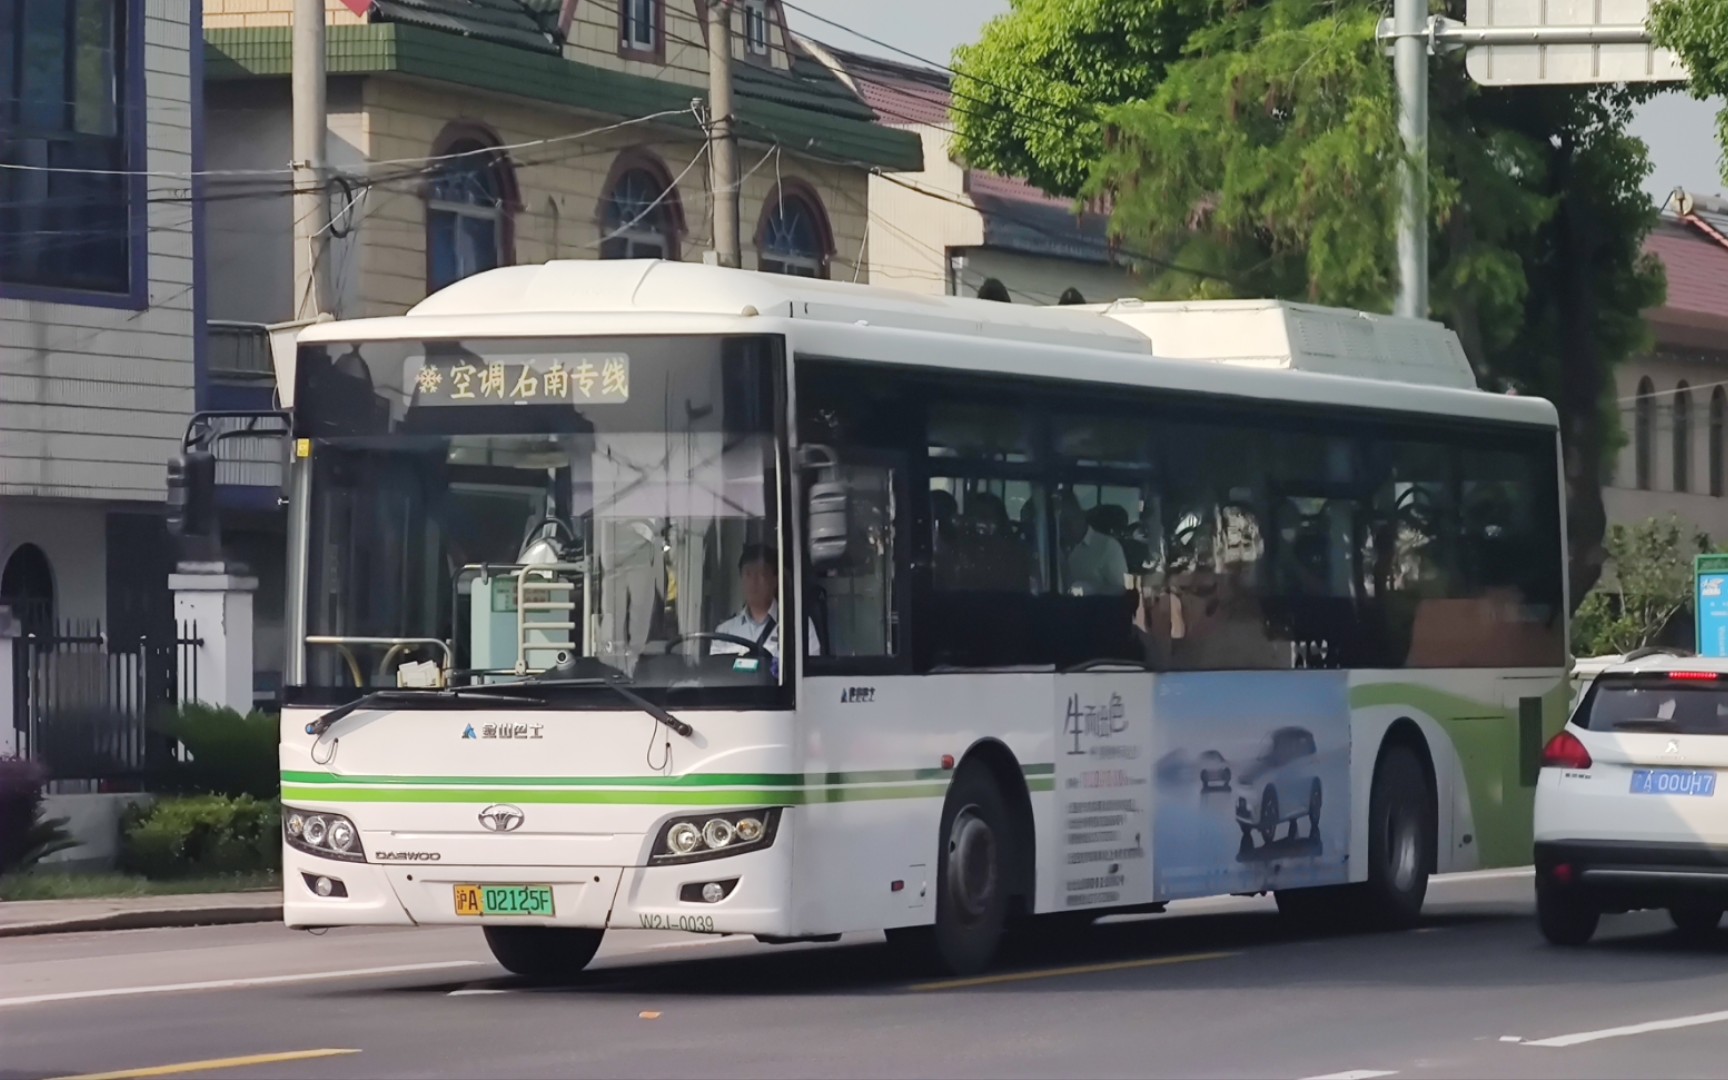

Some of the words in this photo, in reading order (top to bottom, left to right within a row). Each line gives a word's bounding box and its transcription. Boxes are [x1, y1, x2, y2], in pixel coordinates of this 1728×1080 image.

[449, 357, 629, 399] 空调石南专线
[375, 851, 442, 861] DAEWOO
